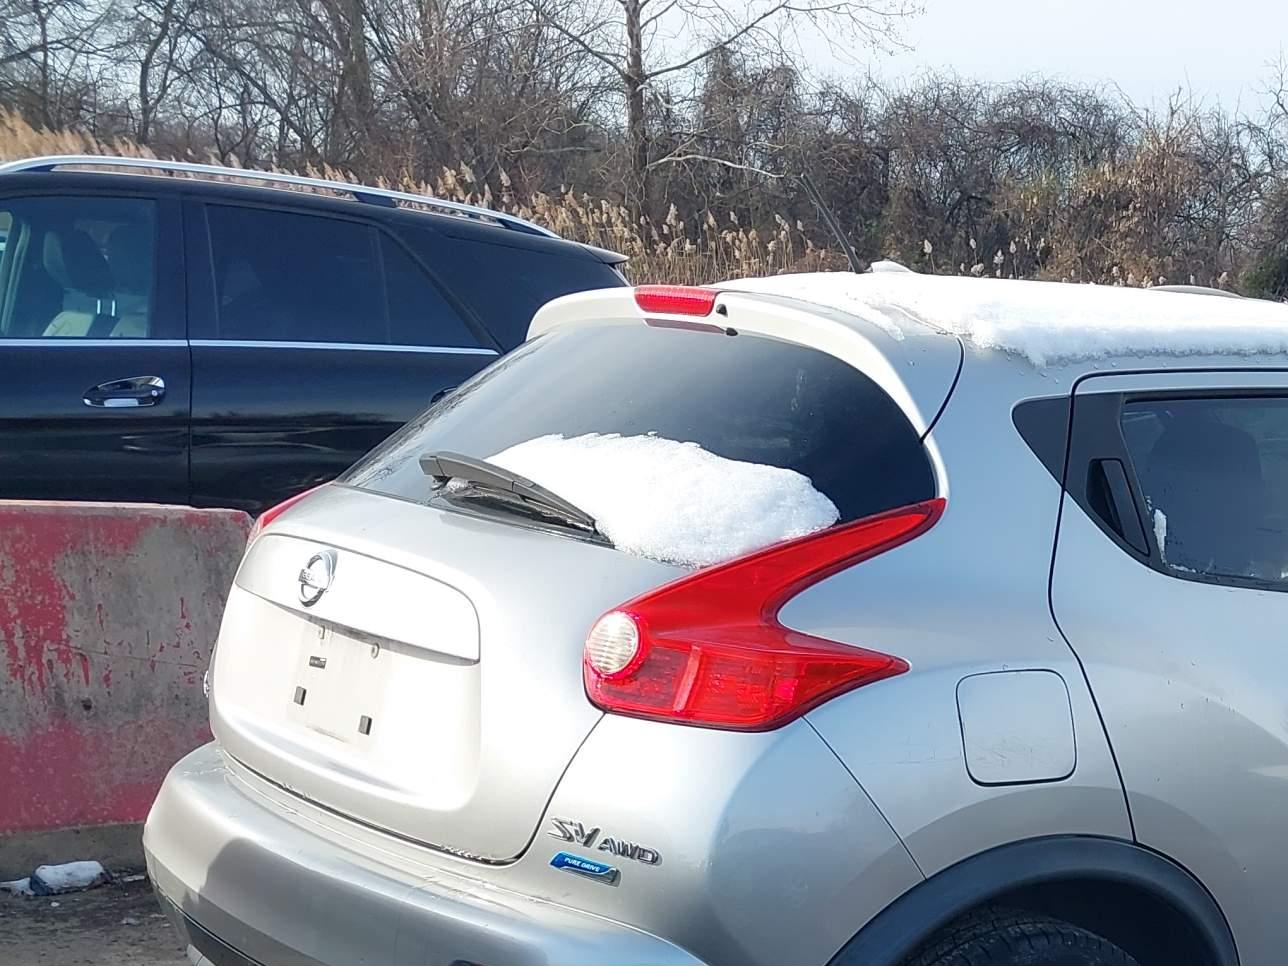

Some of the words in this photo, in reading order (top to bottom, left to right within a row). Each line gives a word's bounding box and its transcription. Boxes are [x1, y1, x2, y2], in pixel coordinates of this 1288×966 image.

[598, 837, 664, 868] AWD
[564, 857, 581, 867] PURE
[581, 861, 601, 873] DRIVE
